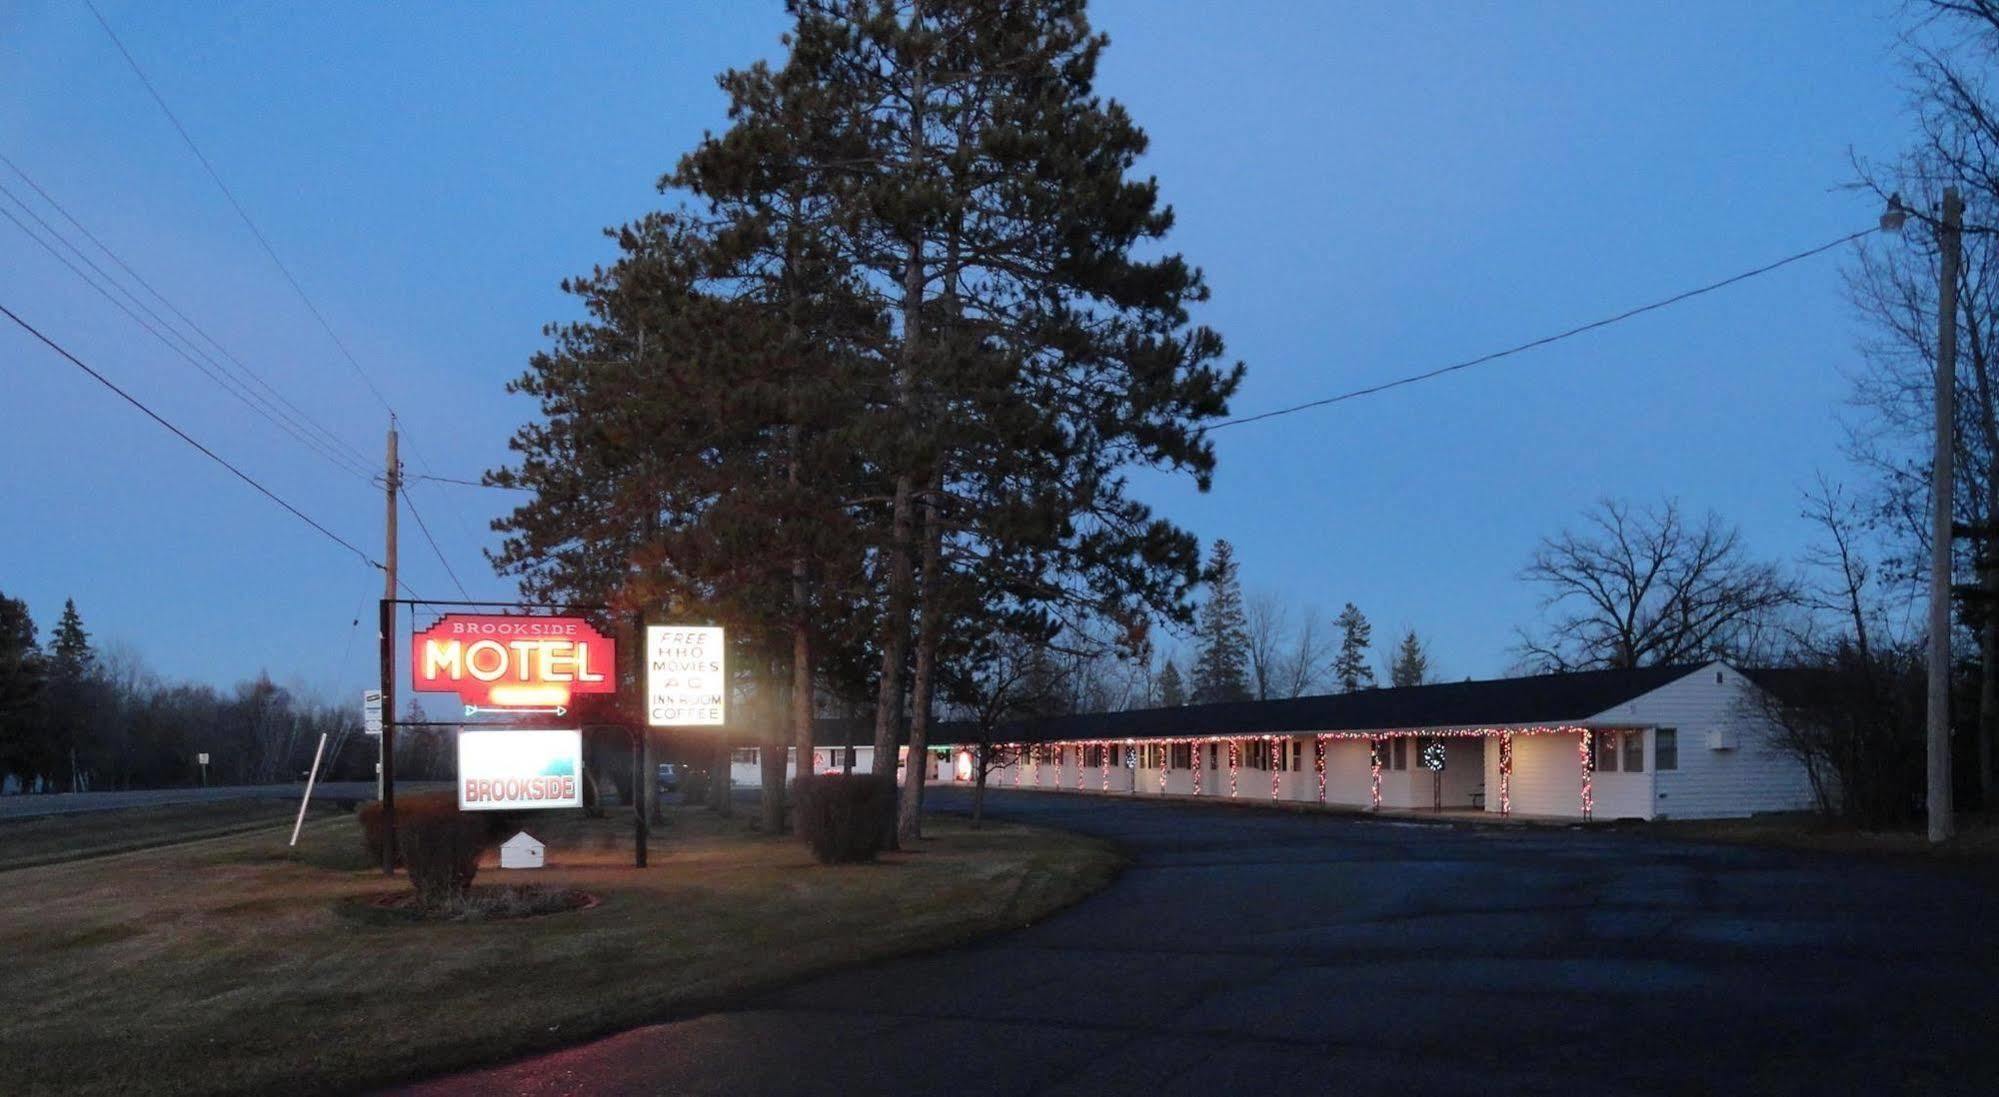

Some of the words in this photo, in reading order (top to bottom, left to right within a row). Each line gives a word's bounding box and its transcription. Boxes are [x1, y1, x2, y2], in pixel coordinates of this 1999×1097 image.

[453, 622, 577, 635] BROOKSIDE
[661, 632, 706, 645] FREE
[425, 639, 605, 682] MOTEL
[653, 661, 719, 672] MOVIES
[653, 708, 719, 720] COFFEE
[465, 777, 576, 802] BROOKSIDE
